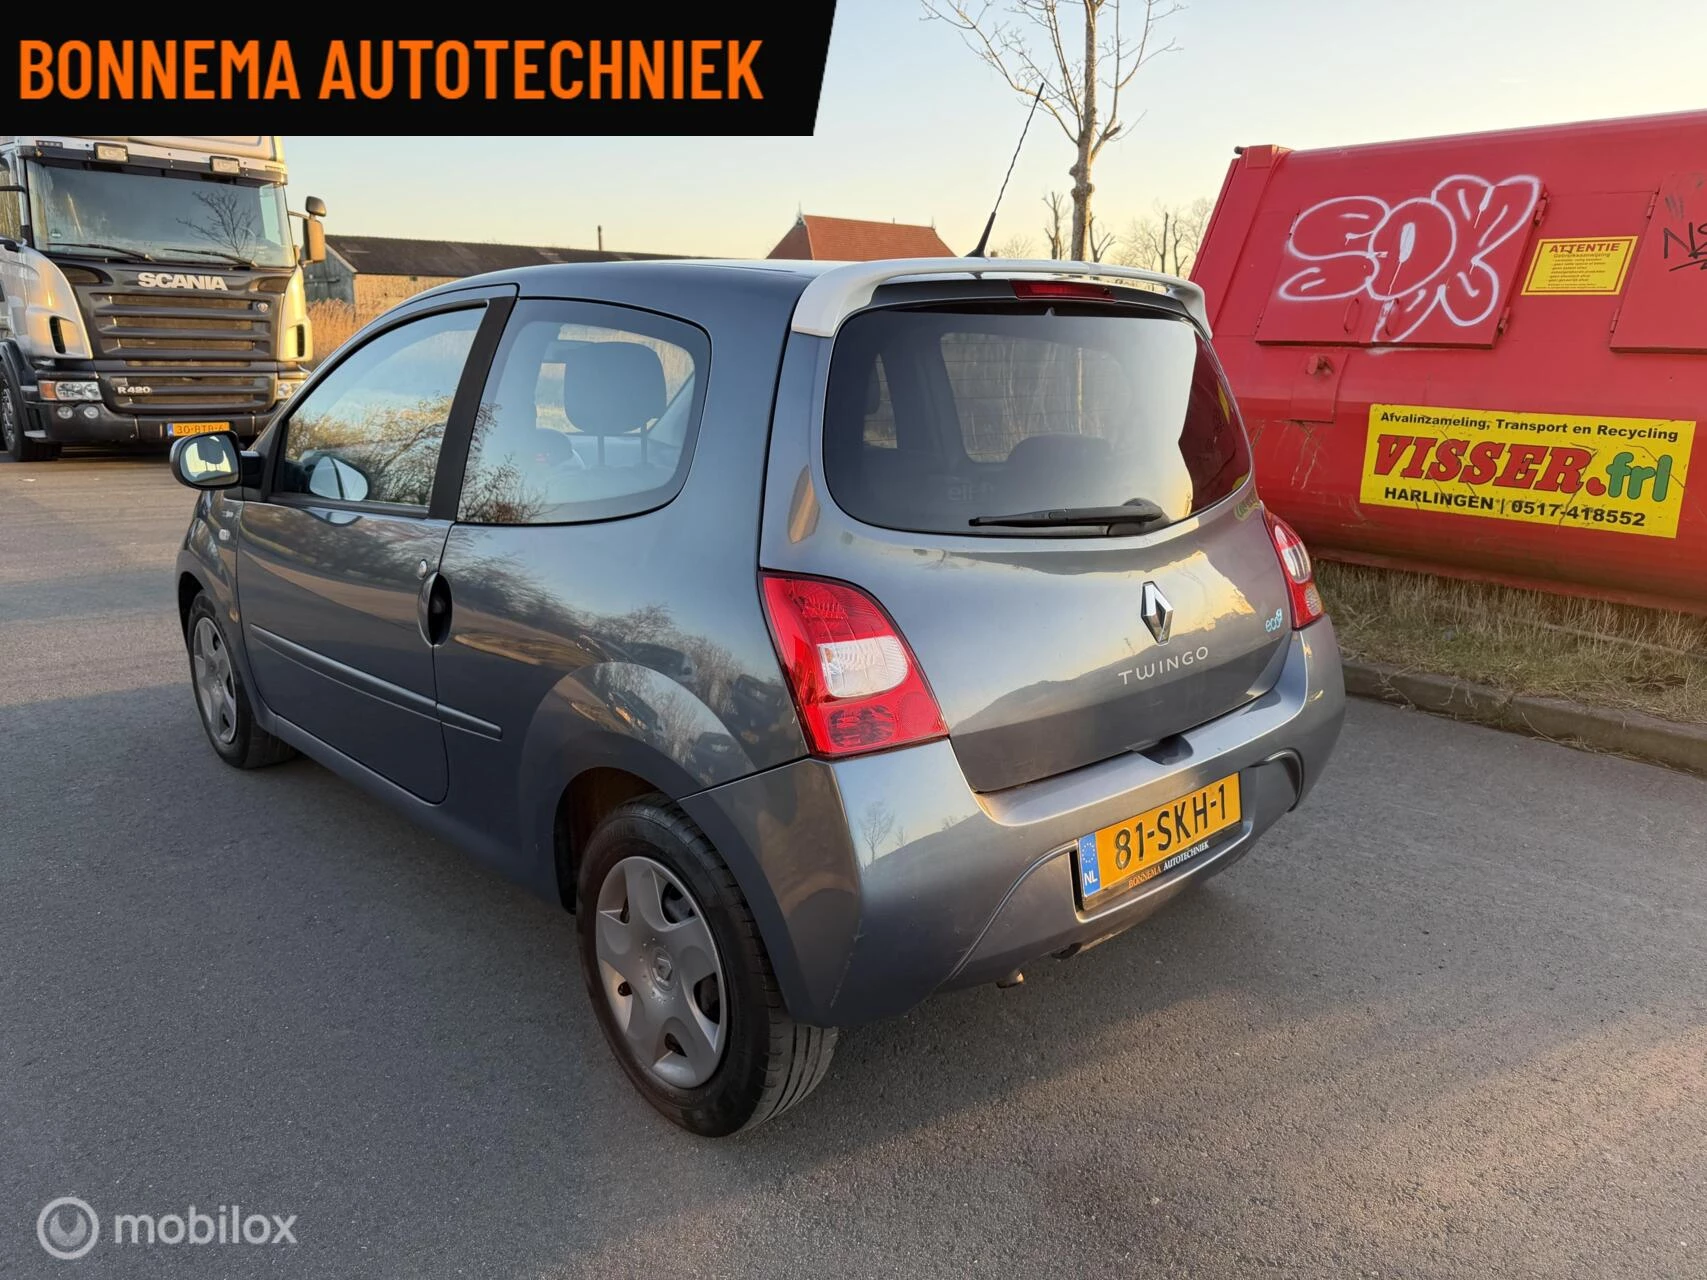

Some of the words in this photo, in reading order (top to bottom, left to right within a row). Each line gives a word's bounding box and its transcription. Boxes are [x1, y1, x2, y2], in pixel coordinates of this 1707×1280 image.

[1549, 243, 1620, 253] ATTENTIE
[138, 272, 228, 291] SCANIA
[1381, 412, 1490, 430] Afvalinzameling,
[1496, 419, 1568, 434] Transport
[1573, 424, 1591, 435] en
[1597, 424, 1679, 443] Recycling
[1384, 487, 1494, 511] HARLINGEN
[1511, 499, 1646, 527] 0517-418552
[1118, 646, 1209, 685] TWINGO
[1115, 783, 1226, 871] 81-SKH-1
[1084, 871, 1098, 886] NL
[1128, 865, 1161, 888] BONNEMA
[1163, 841, 1209, 871] AUTOTECHNIEK
